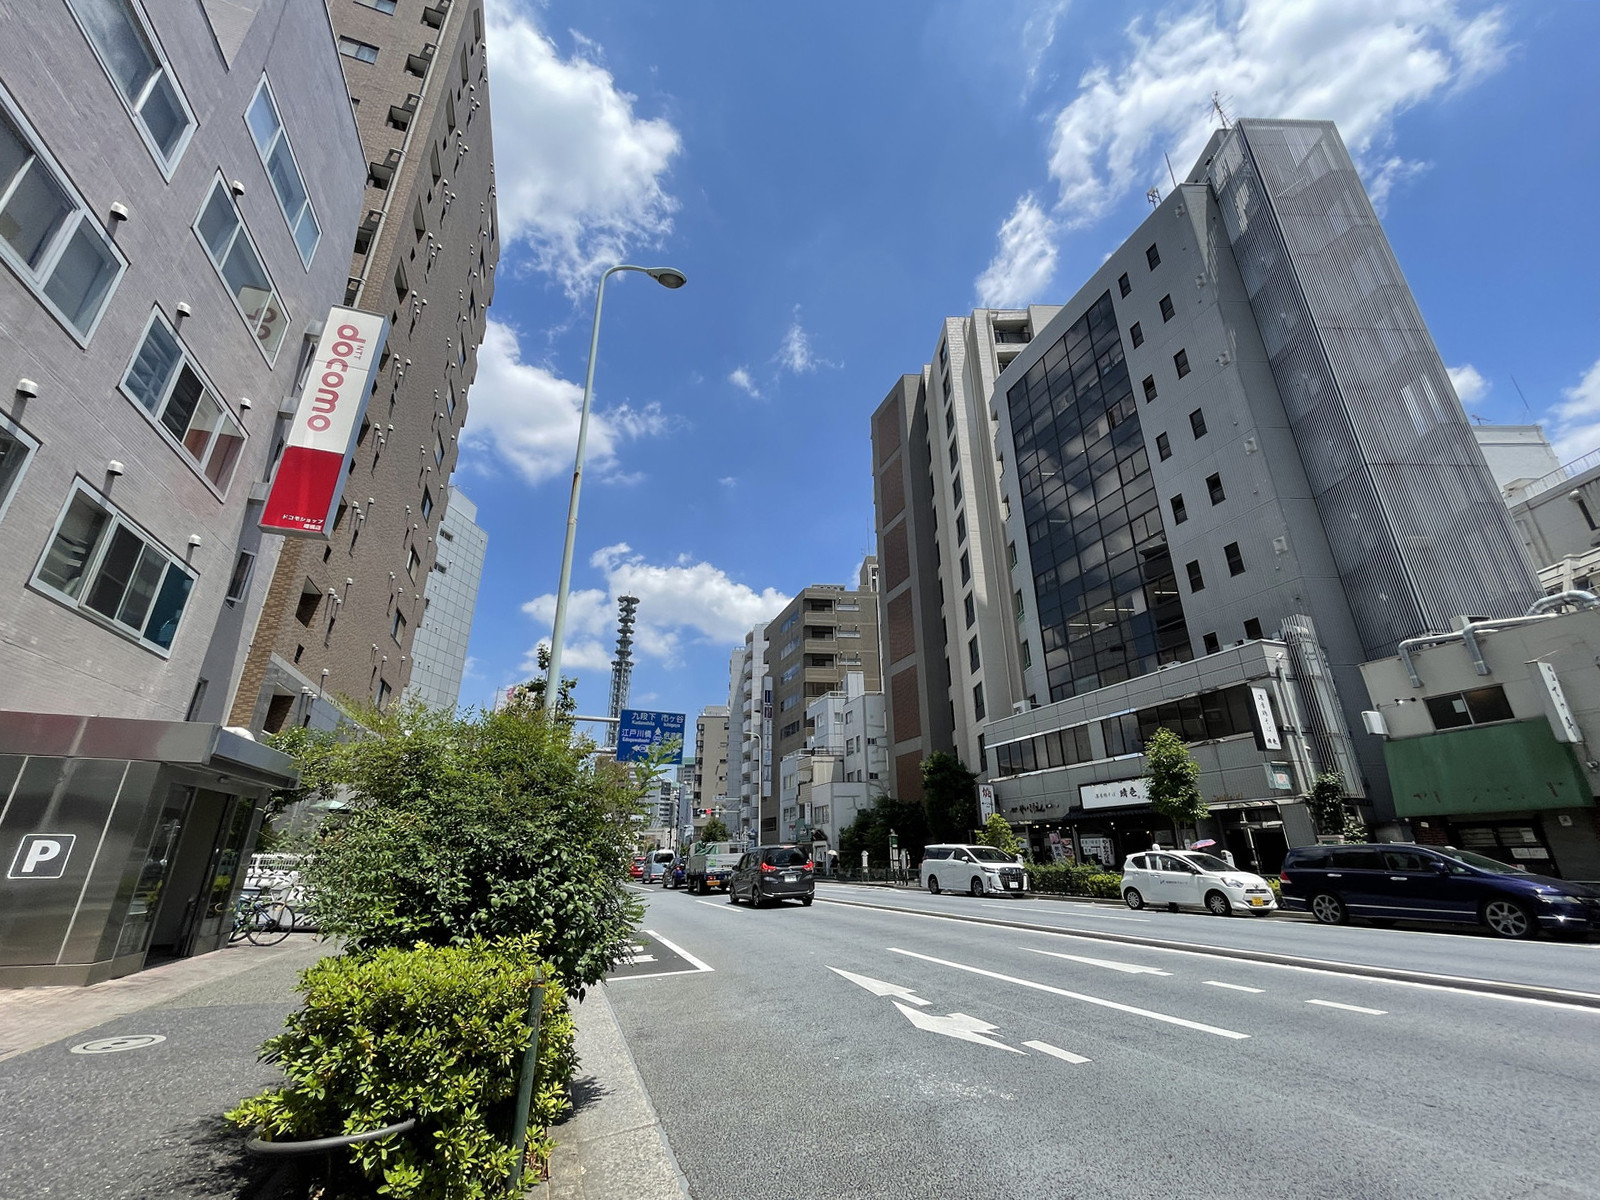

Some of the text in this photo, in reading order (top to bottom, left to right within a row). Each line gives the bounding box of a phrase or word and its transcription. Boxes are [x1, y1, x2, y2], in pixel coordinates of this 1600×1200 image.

[353, 344, 365, 361] NTT
[306, 324, 367, 432] docomo
[282, 514, 324, 524] ドコモショップ
[631, 712, 656, 721] 九段下
[621, 728, 652, 738] 江戸川橋
[21, 840, 61, 873] P
